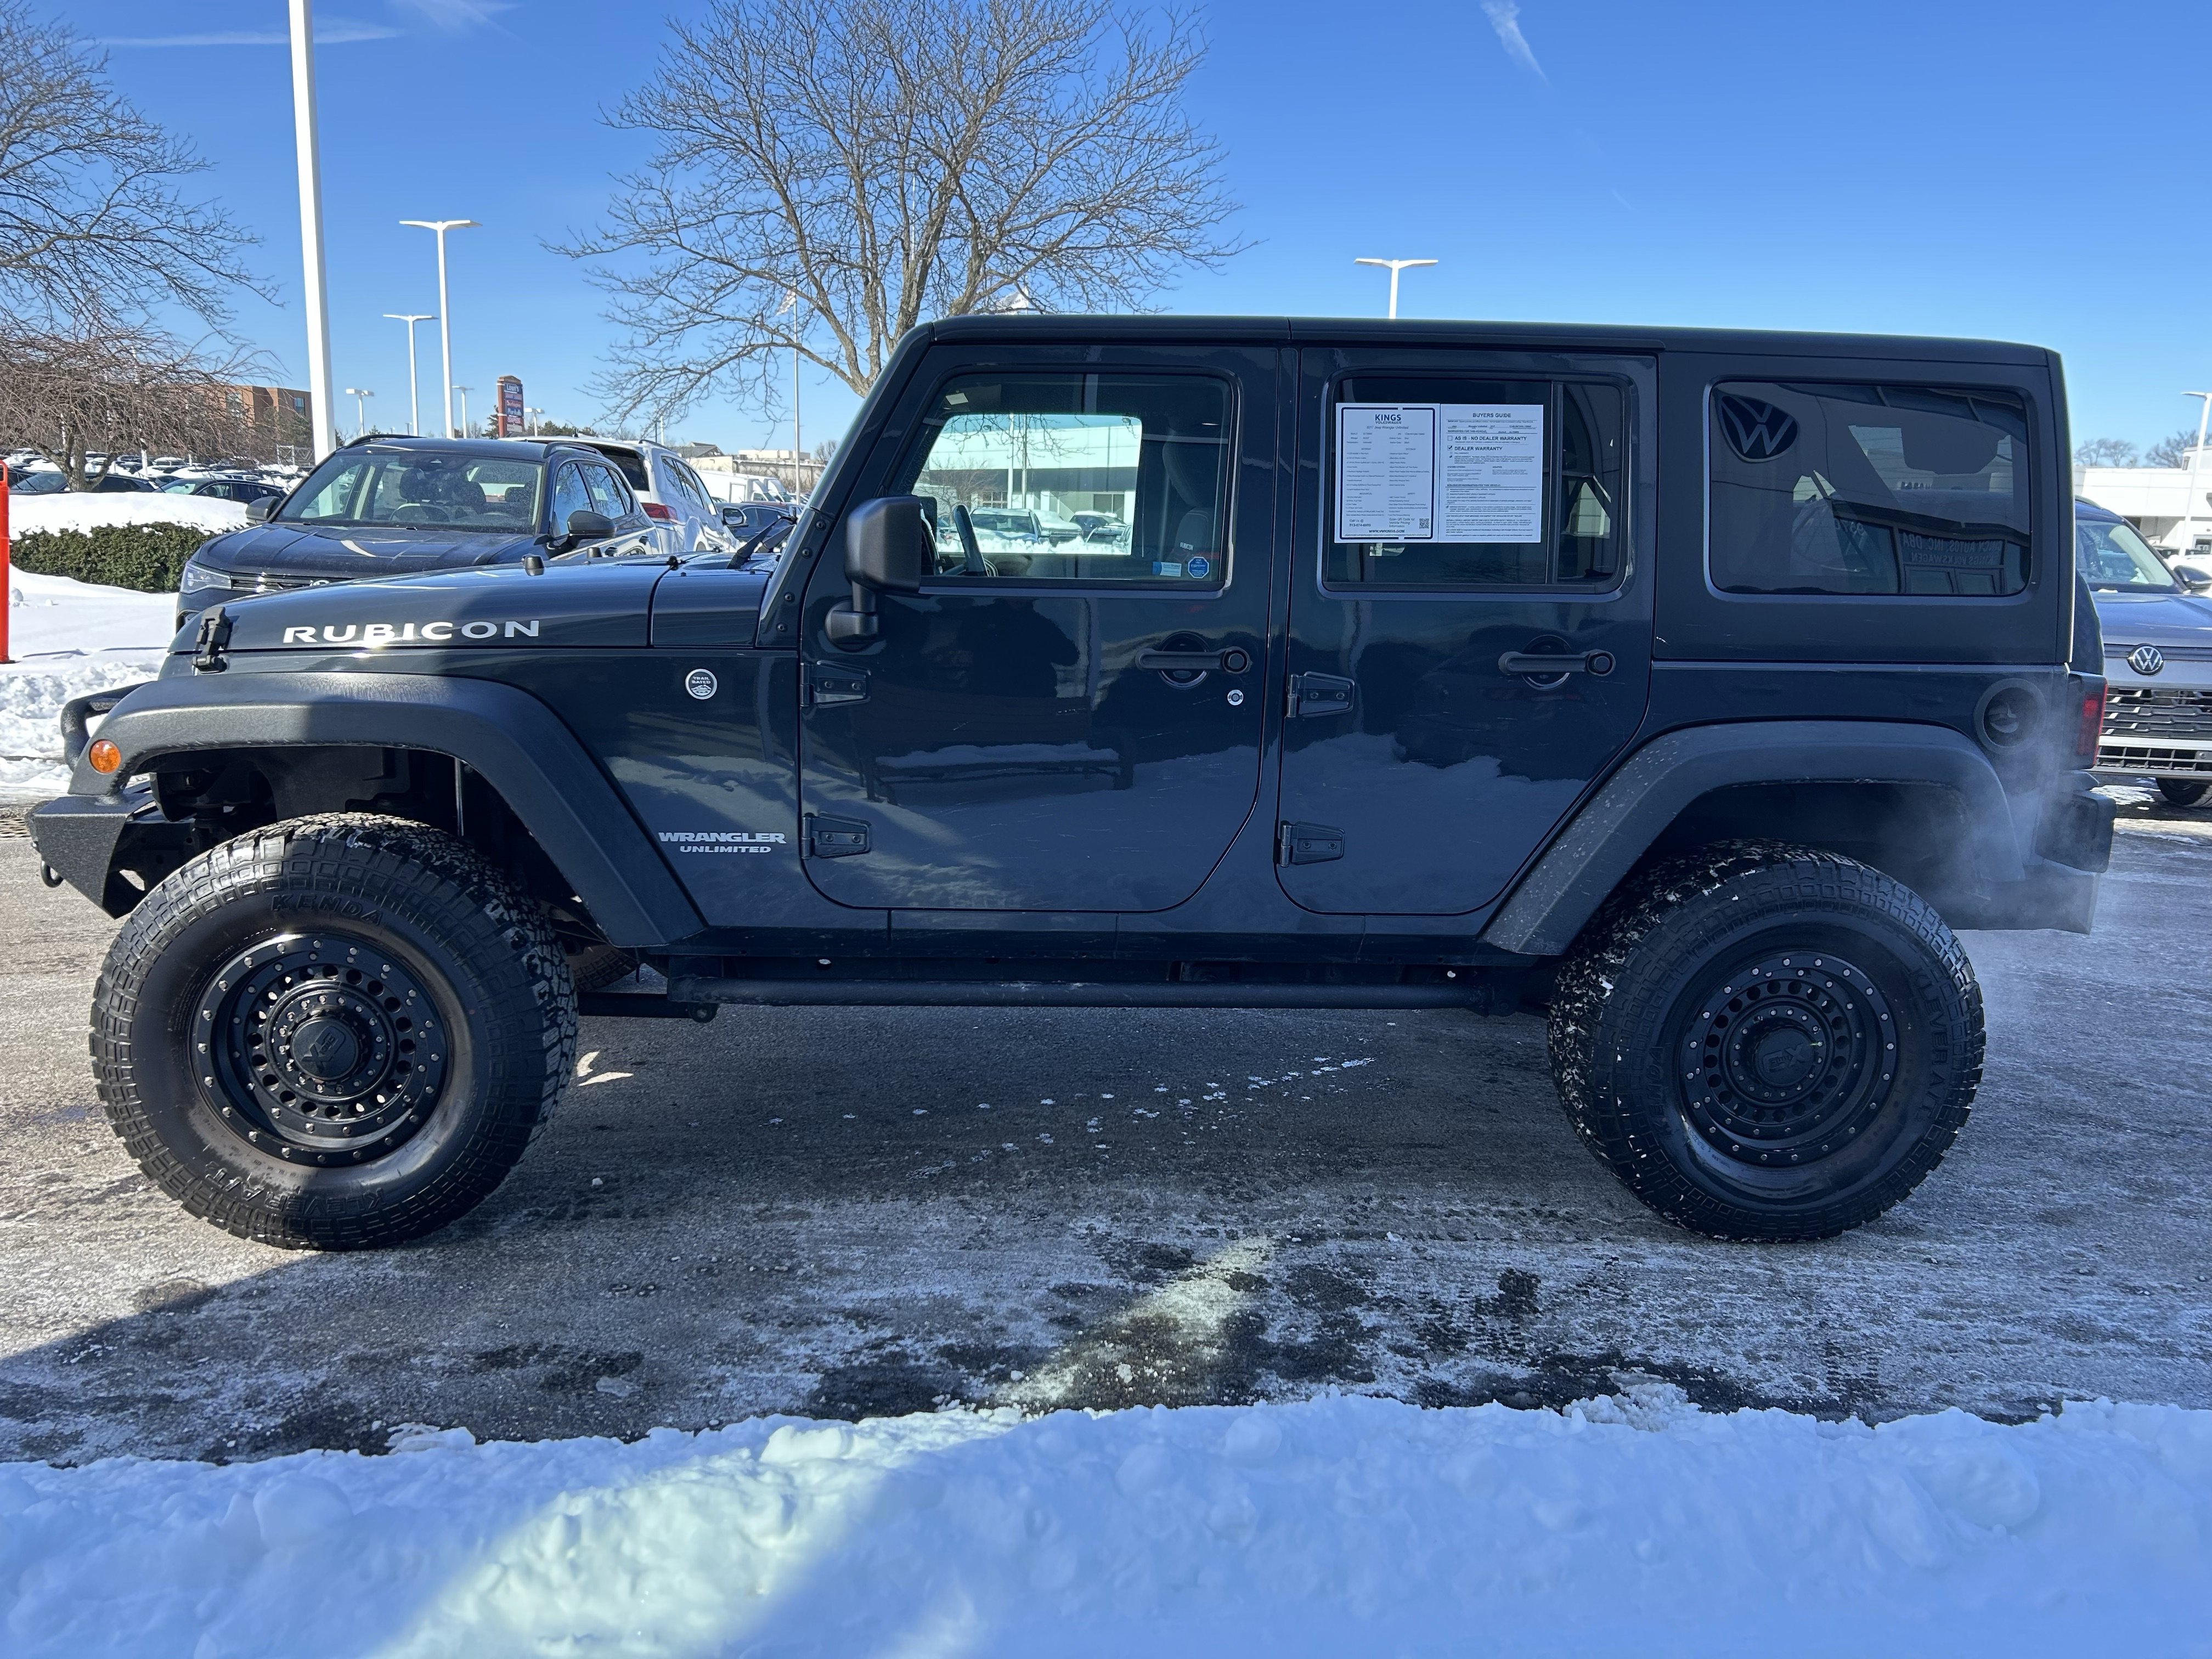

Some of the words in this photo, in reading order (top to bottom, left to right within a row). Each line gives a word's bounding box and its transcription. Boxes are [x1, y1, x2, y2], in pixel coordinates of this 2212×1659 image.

[283, 620, 540, 644] RUBICON
[658, 832, 787, 844] WRANGLER
[271, 894, 383, 926] KENDA
[1912, 969, 1948, 1065] KLEVER
[1647, 1046, 1672, 1137] KENDA
[264, 1188, 383, 1216] KLEVER
